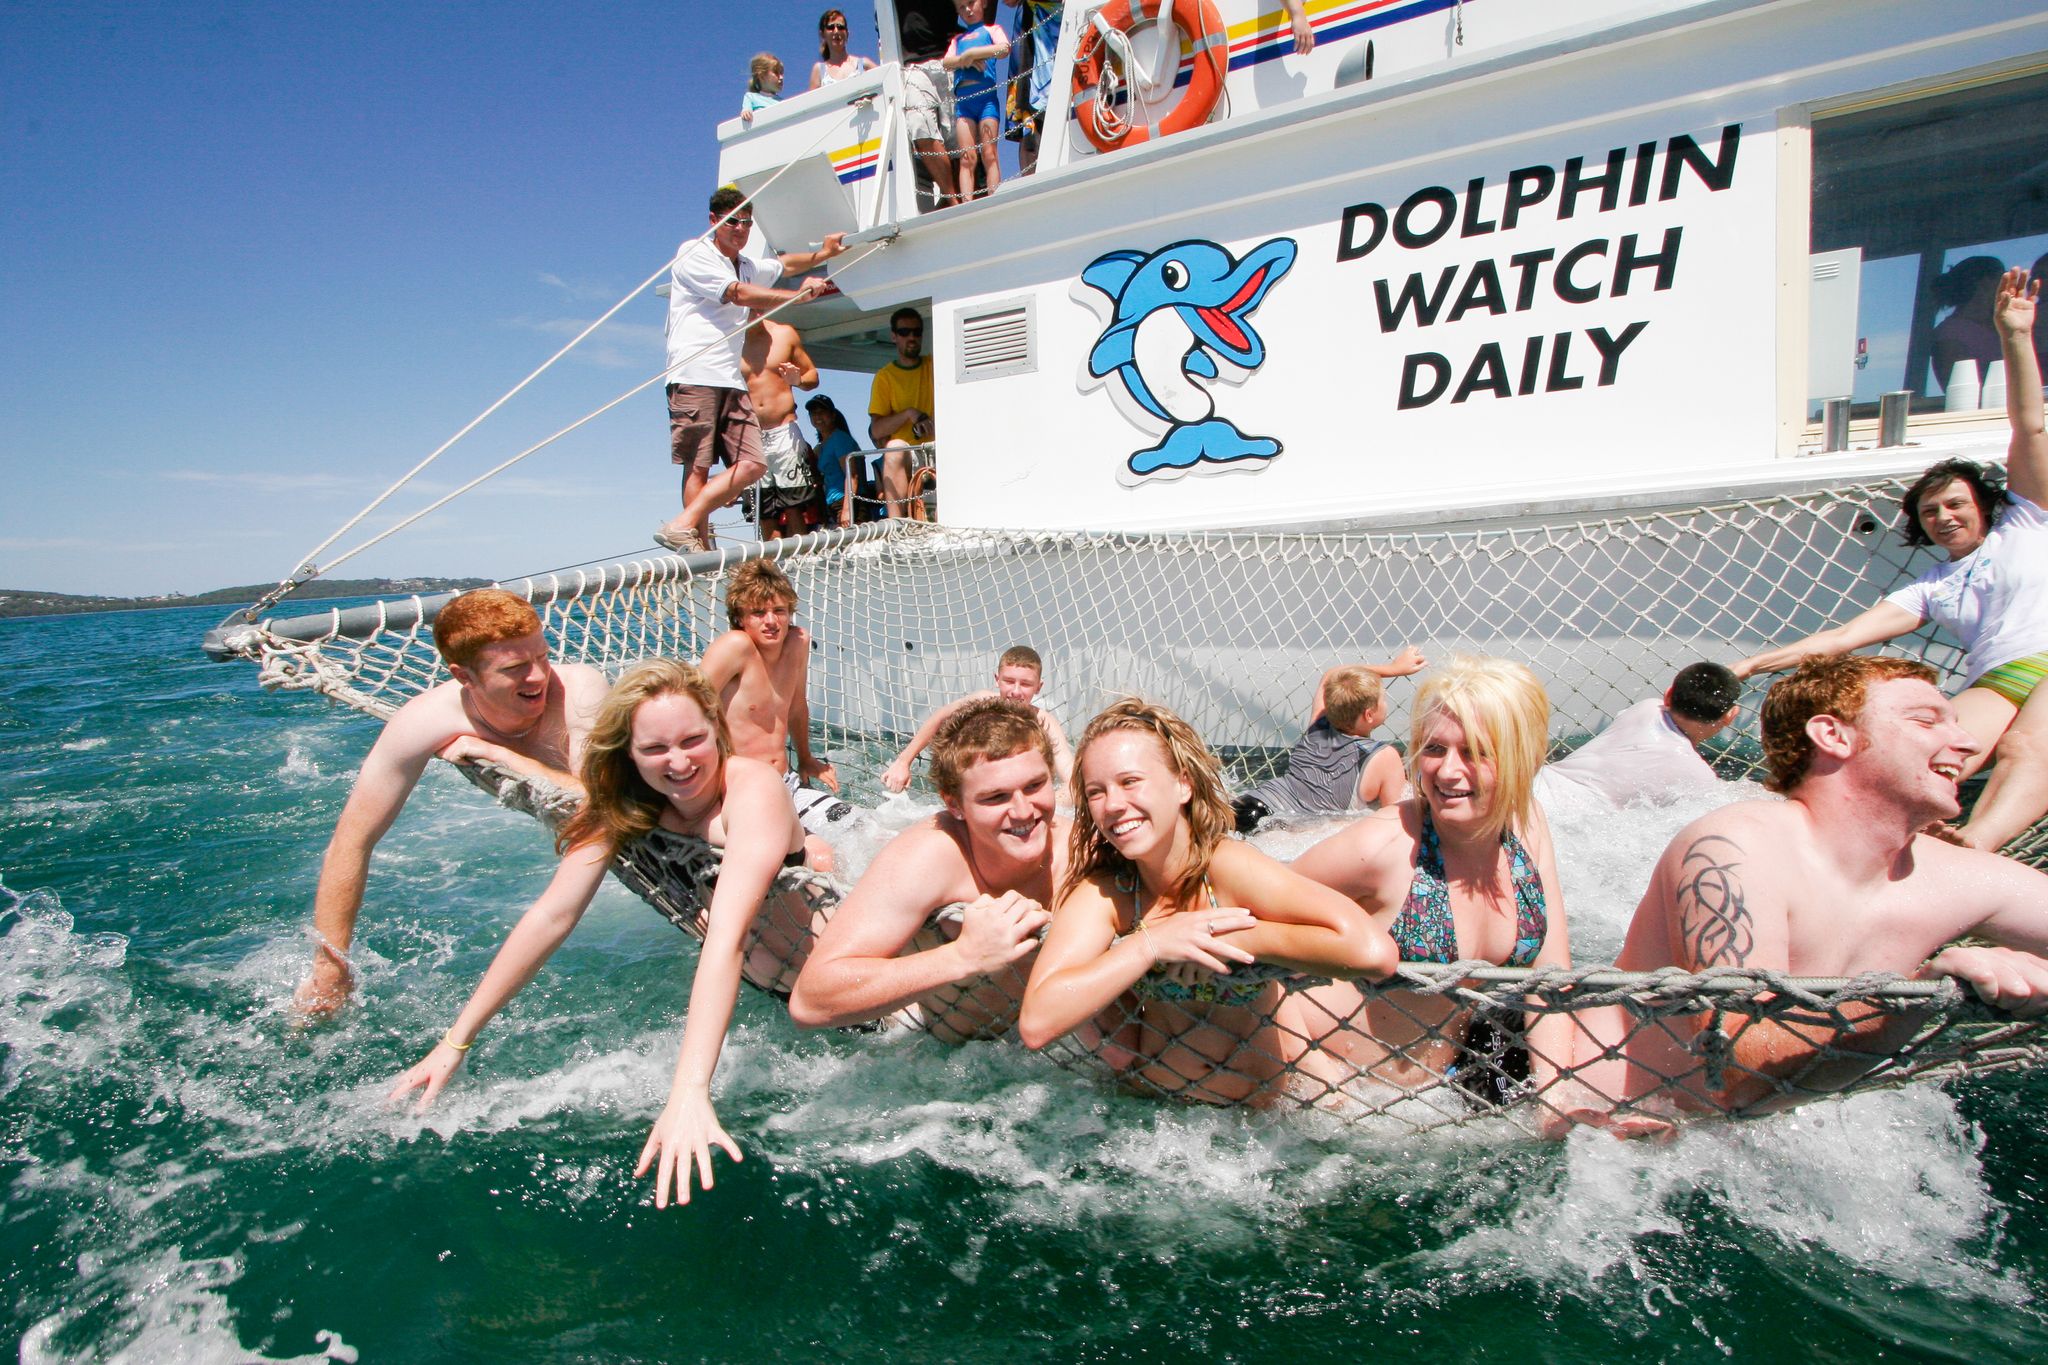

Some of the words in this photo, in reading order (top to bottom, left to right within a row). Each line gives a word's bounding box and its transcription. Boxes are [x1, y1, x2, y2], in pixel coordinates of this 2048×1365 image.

[1337, 123, 1741, 262] DOLPHIN
[1373, 226, 1683, 333] WATCH
[1397, 320, 1649, 411] DAILY
